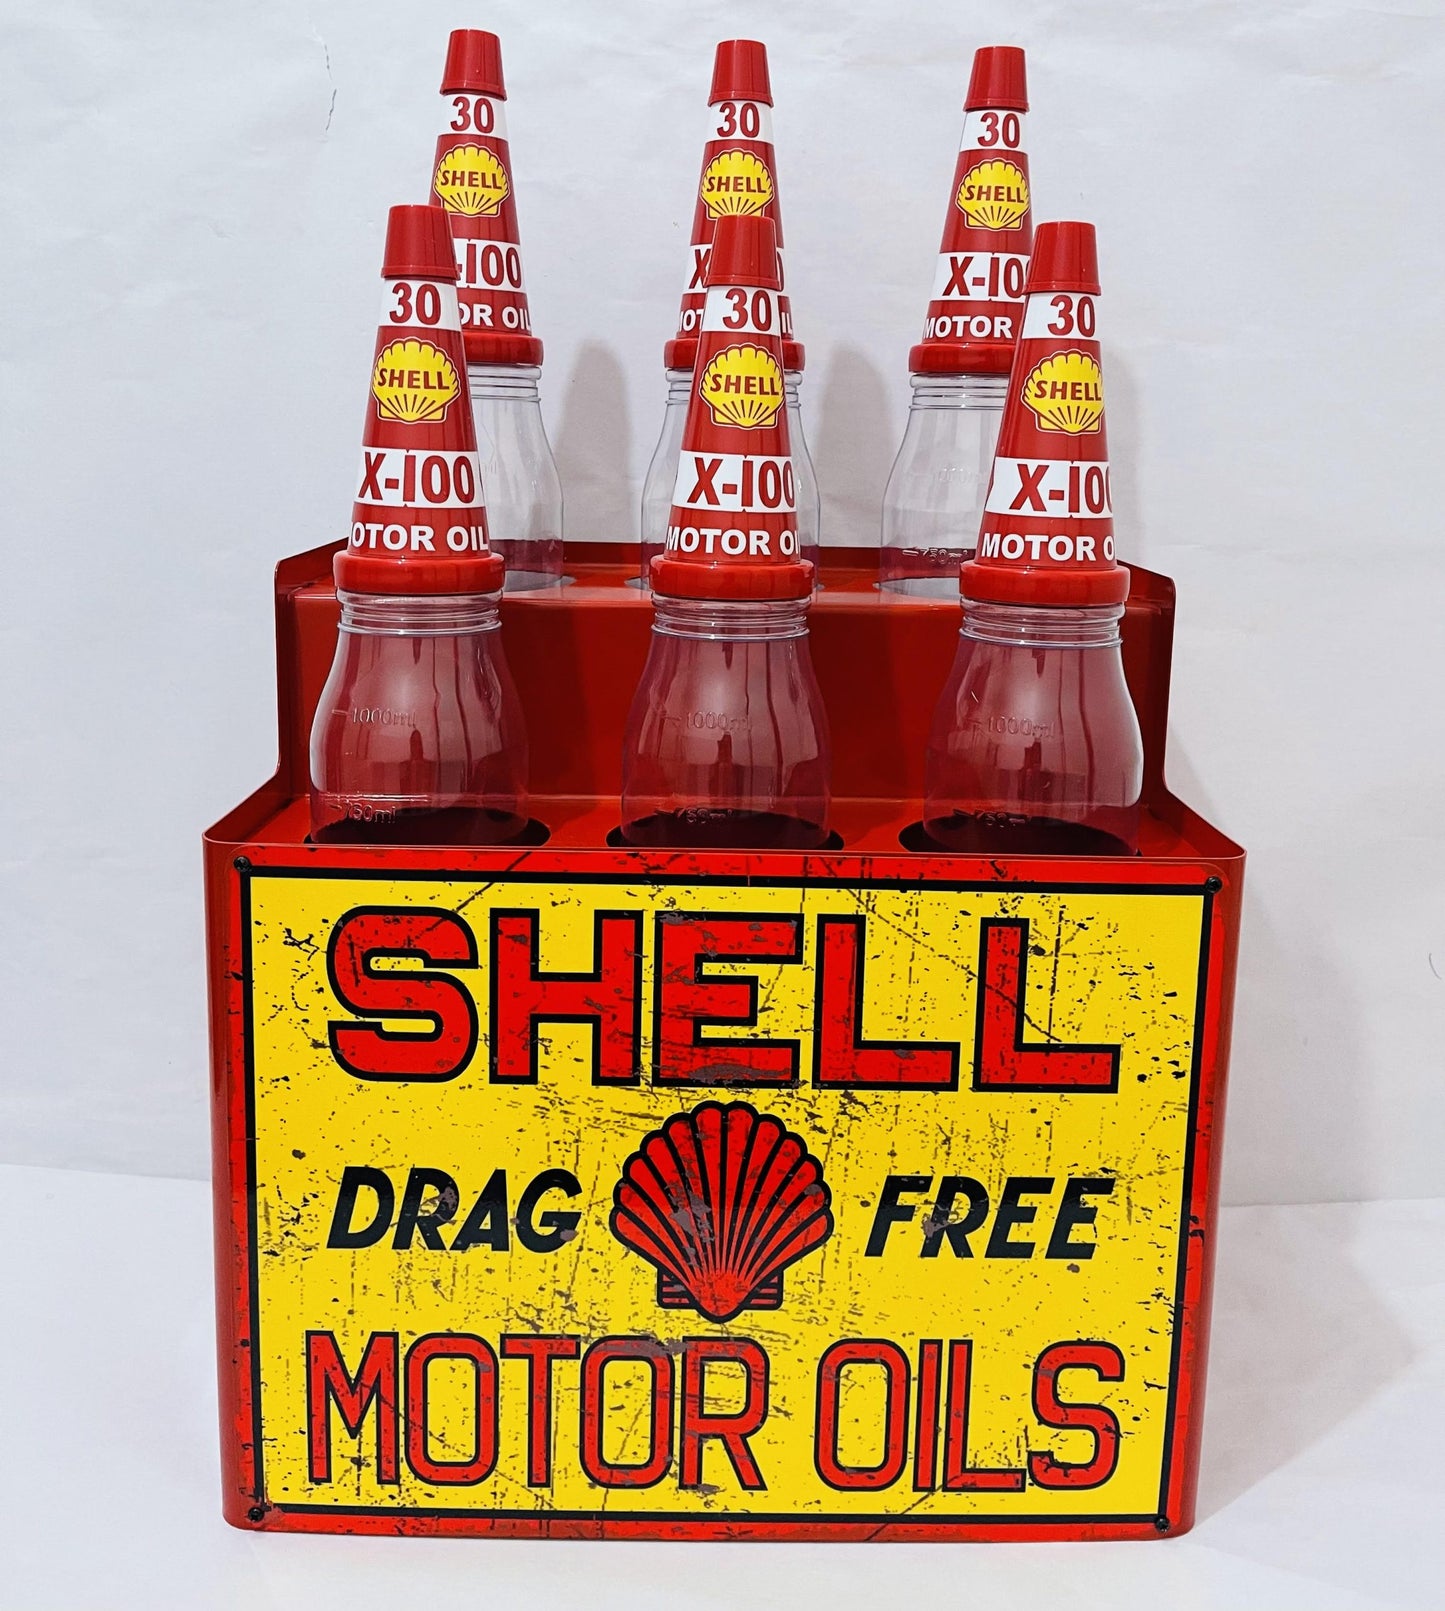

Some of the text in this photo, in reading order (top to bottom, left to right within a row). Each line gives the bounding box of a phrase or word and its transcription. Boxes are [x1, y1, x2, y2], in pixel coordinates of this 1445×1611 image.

[450, 96, 494, 134] 30
[716, 102, 760, 138] 30
[977, 112, 1021, 149] 30
[440, 170, 502, 190] SHELL
[706, 175, 767, 195] SHELL
[964, 185, 1025, 203] SHELL
[942, 256, 1031, 299] X-10
[389, 282, 441, 325] 30
[722, 288, 772, 331] 30
[1047, 294, 1095, 338] 30
[378, 367, 450, 391] SHELL
[710, 373, 780, 396] SHELL
[1034, 380, 1102, 402] SHELL
[358, 452, 475, 503] X-100
[687, 457, 795, 508] X-100
[351, 521, 488, 552] OTOR OIL
[666, 526, 771, 556] MOTOR
[981, 532, 1096, 561] MOTOR
[326, 905, 1121, 1093] SHELL
[326, 1167, 1116, 1260] DRAG FREE
[305, 1331, 1126, 1493] MOTOR OILS
